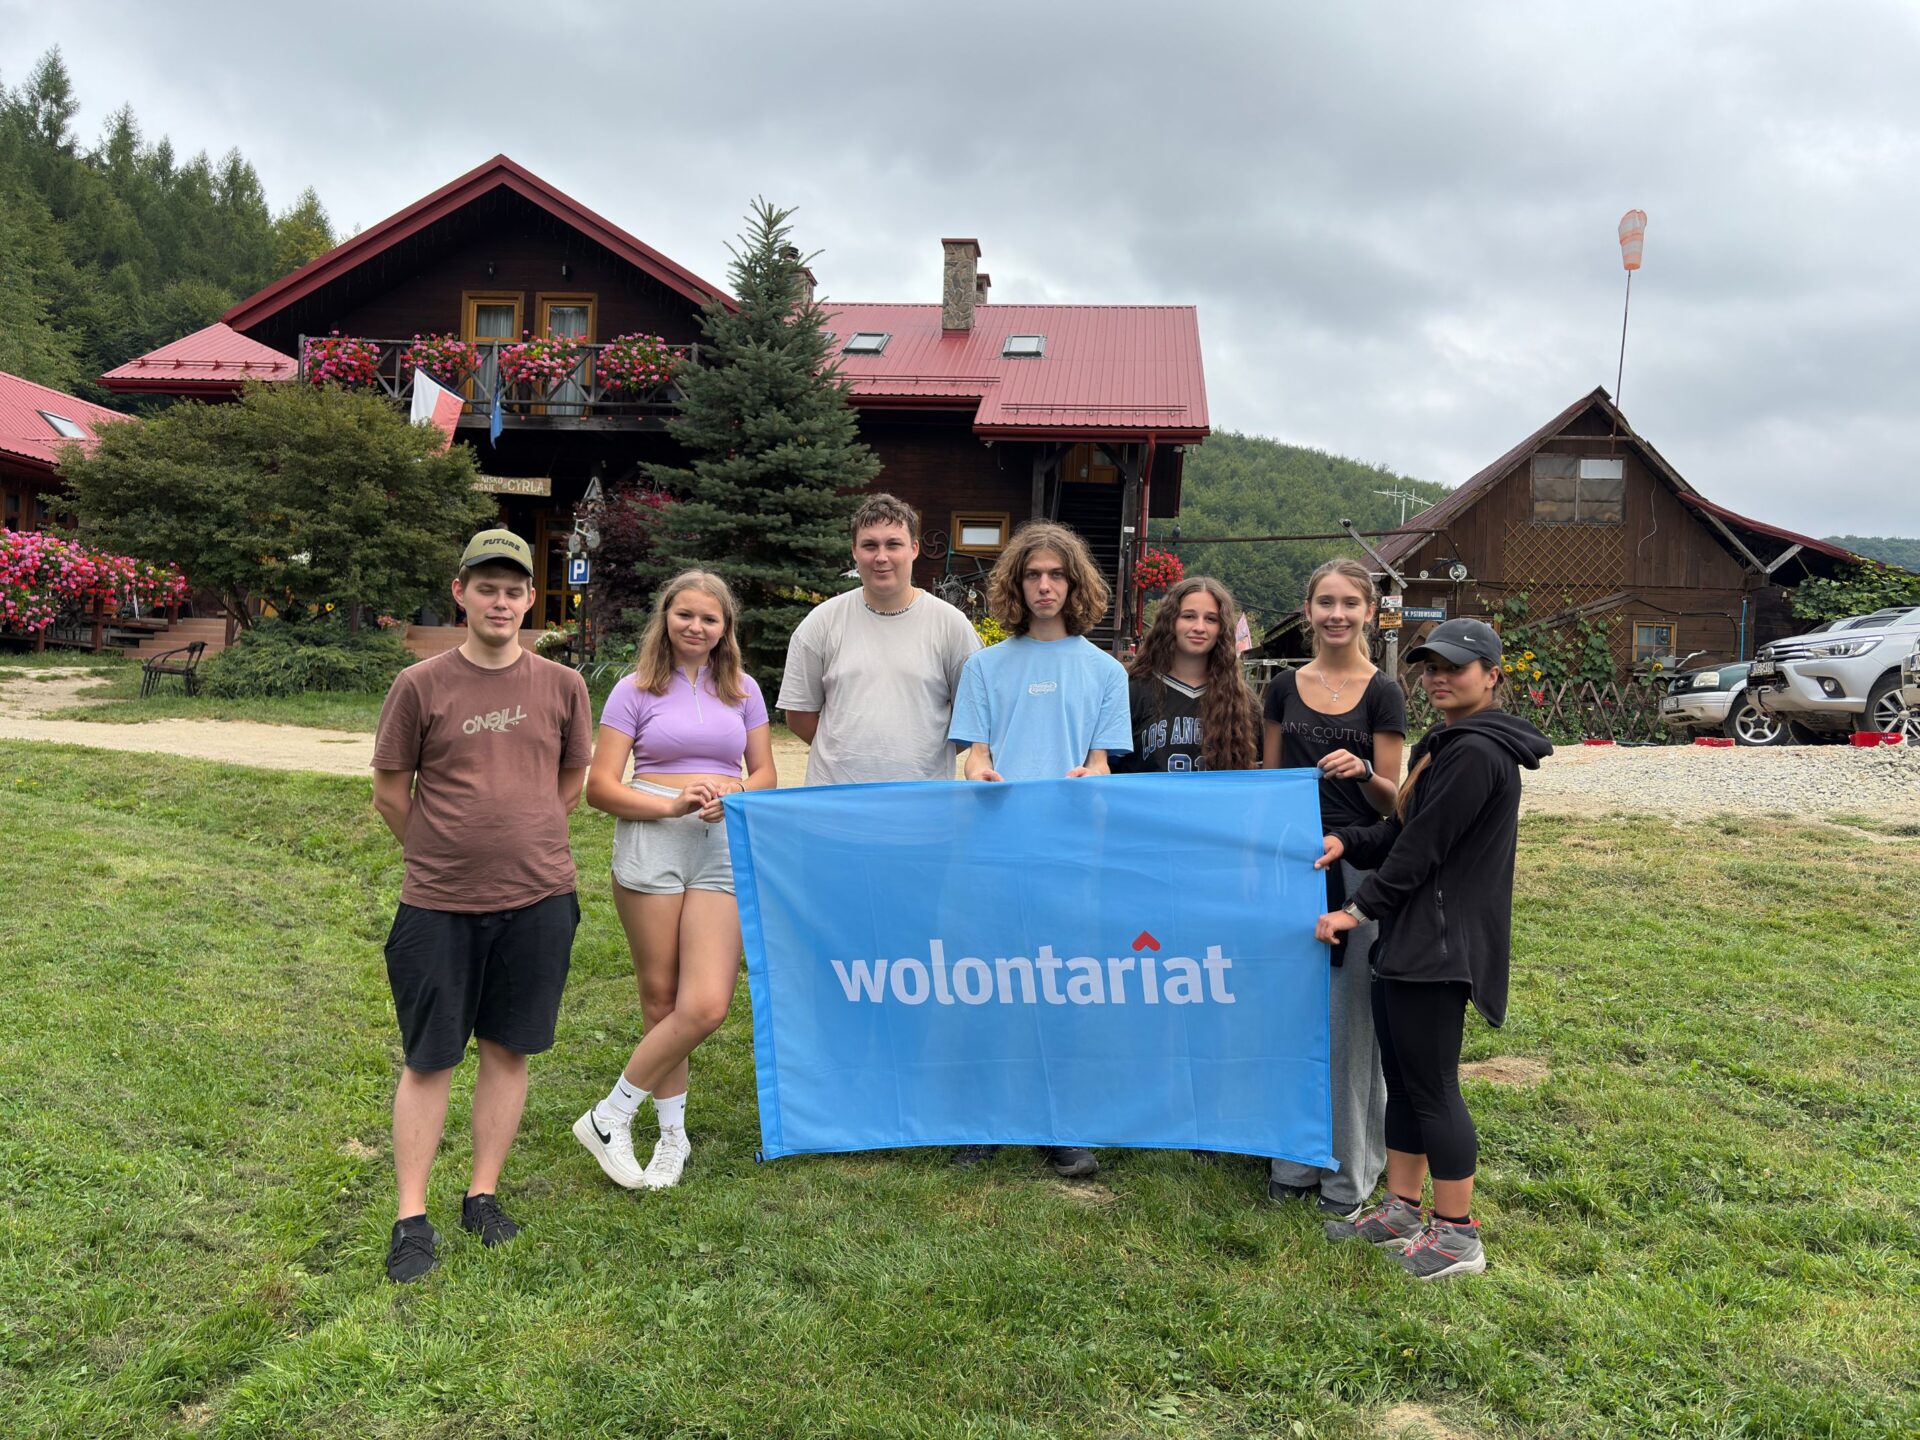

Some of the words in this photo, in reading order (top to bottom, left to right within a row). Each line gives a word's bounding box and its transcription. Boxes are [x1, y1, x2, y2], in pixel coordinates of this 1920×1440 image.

[472, 482, 496, 492] RSKIE
[480, 476, 503, 484] NISKO
[507, 479, 545, 494] CYRLA
[483, 538, 521, 552] FUTURE
[573, 559, 585, 580] P
[1141, 719, 1168, 761] LOS
[1170, 716, 1204, 745] ANG
[830, 931, 1236, 1005] wolontariat
